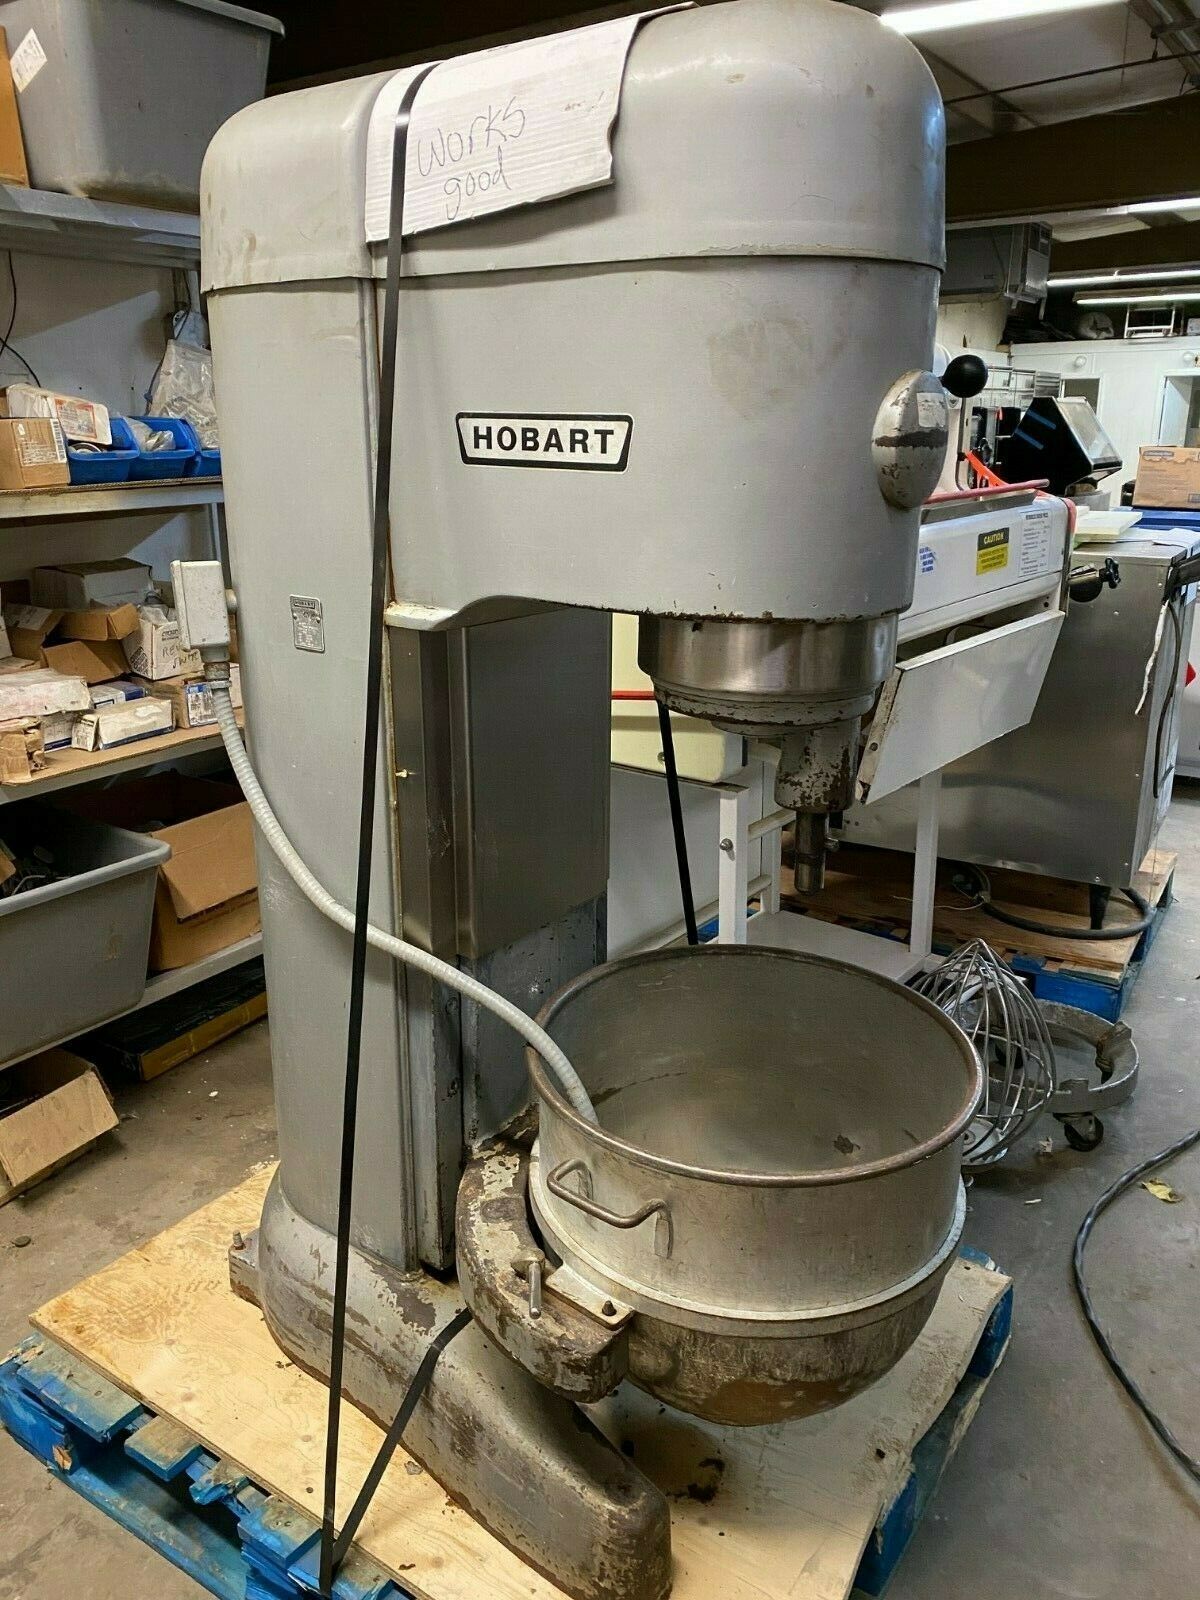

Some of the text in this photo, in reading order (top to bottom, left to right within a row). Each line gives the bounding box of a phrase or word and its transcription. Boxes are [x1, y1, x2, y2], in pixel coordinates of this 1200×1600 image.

[444, 145, 512, 220] good
[473, 426, 614, 454] HOBART
[983, 532, 1004, 545] CAUTION
